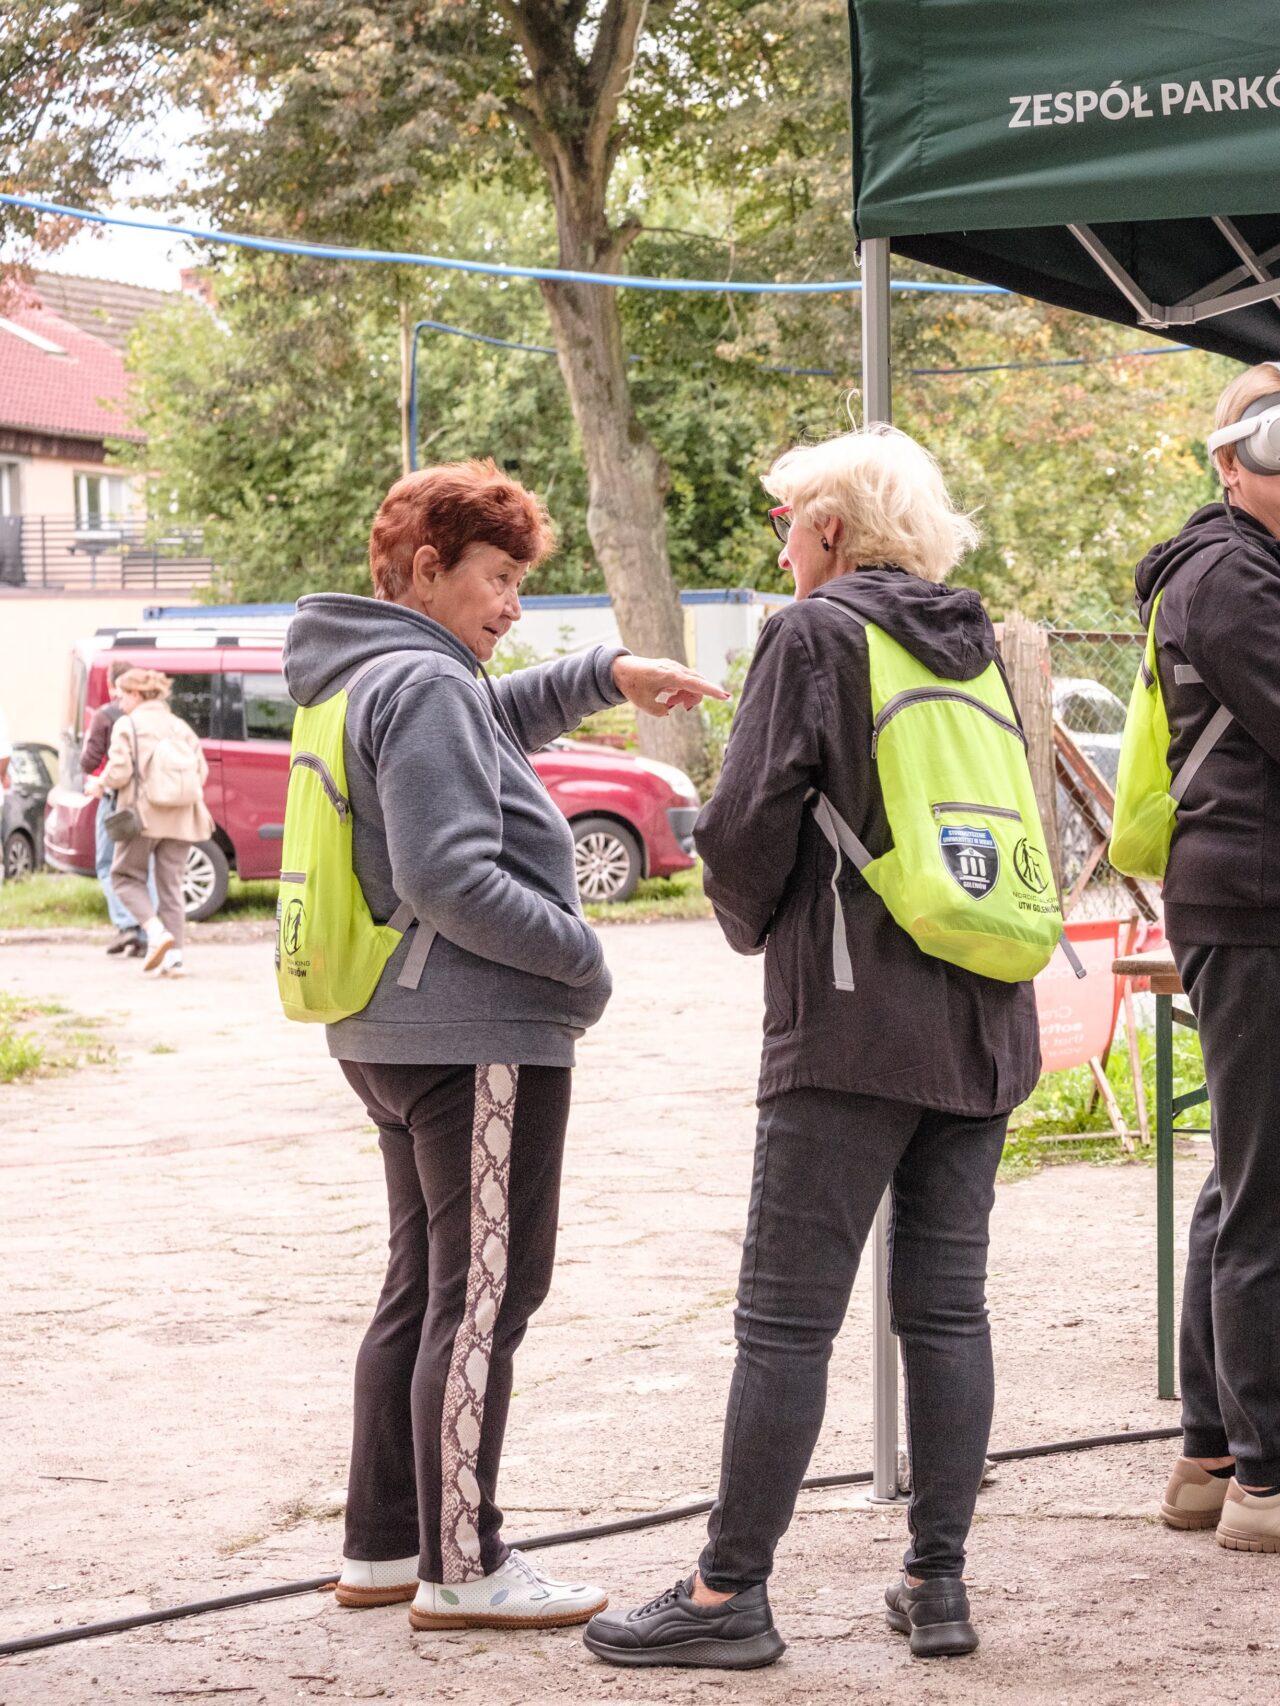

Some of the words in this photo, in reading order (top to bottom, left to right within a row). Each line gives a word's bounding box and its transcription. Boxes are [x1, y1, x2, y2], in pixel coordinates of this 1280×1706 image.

[1008, 80, 1154, 128] ZESPÓŁ
[1012, 891, 1037, 902] NORDIC
[1018, 901, 1032, 911] UTW
